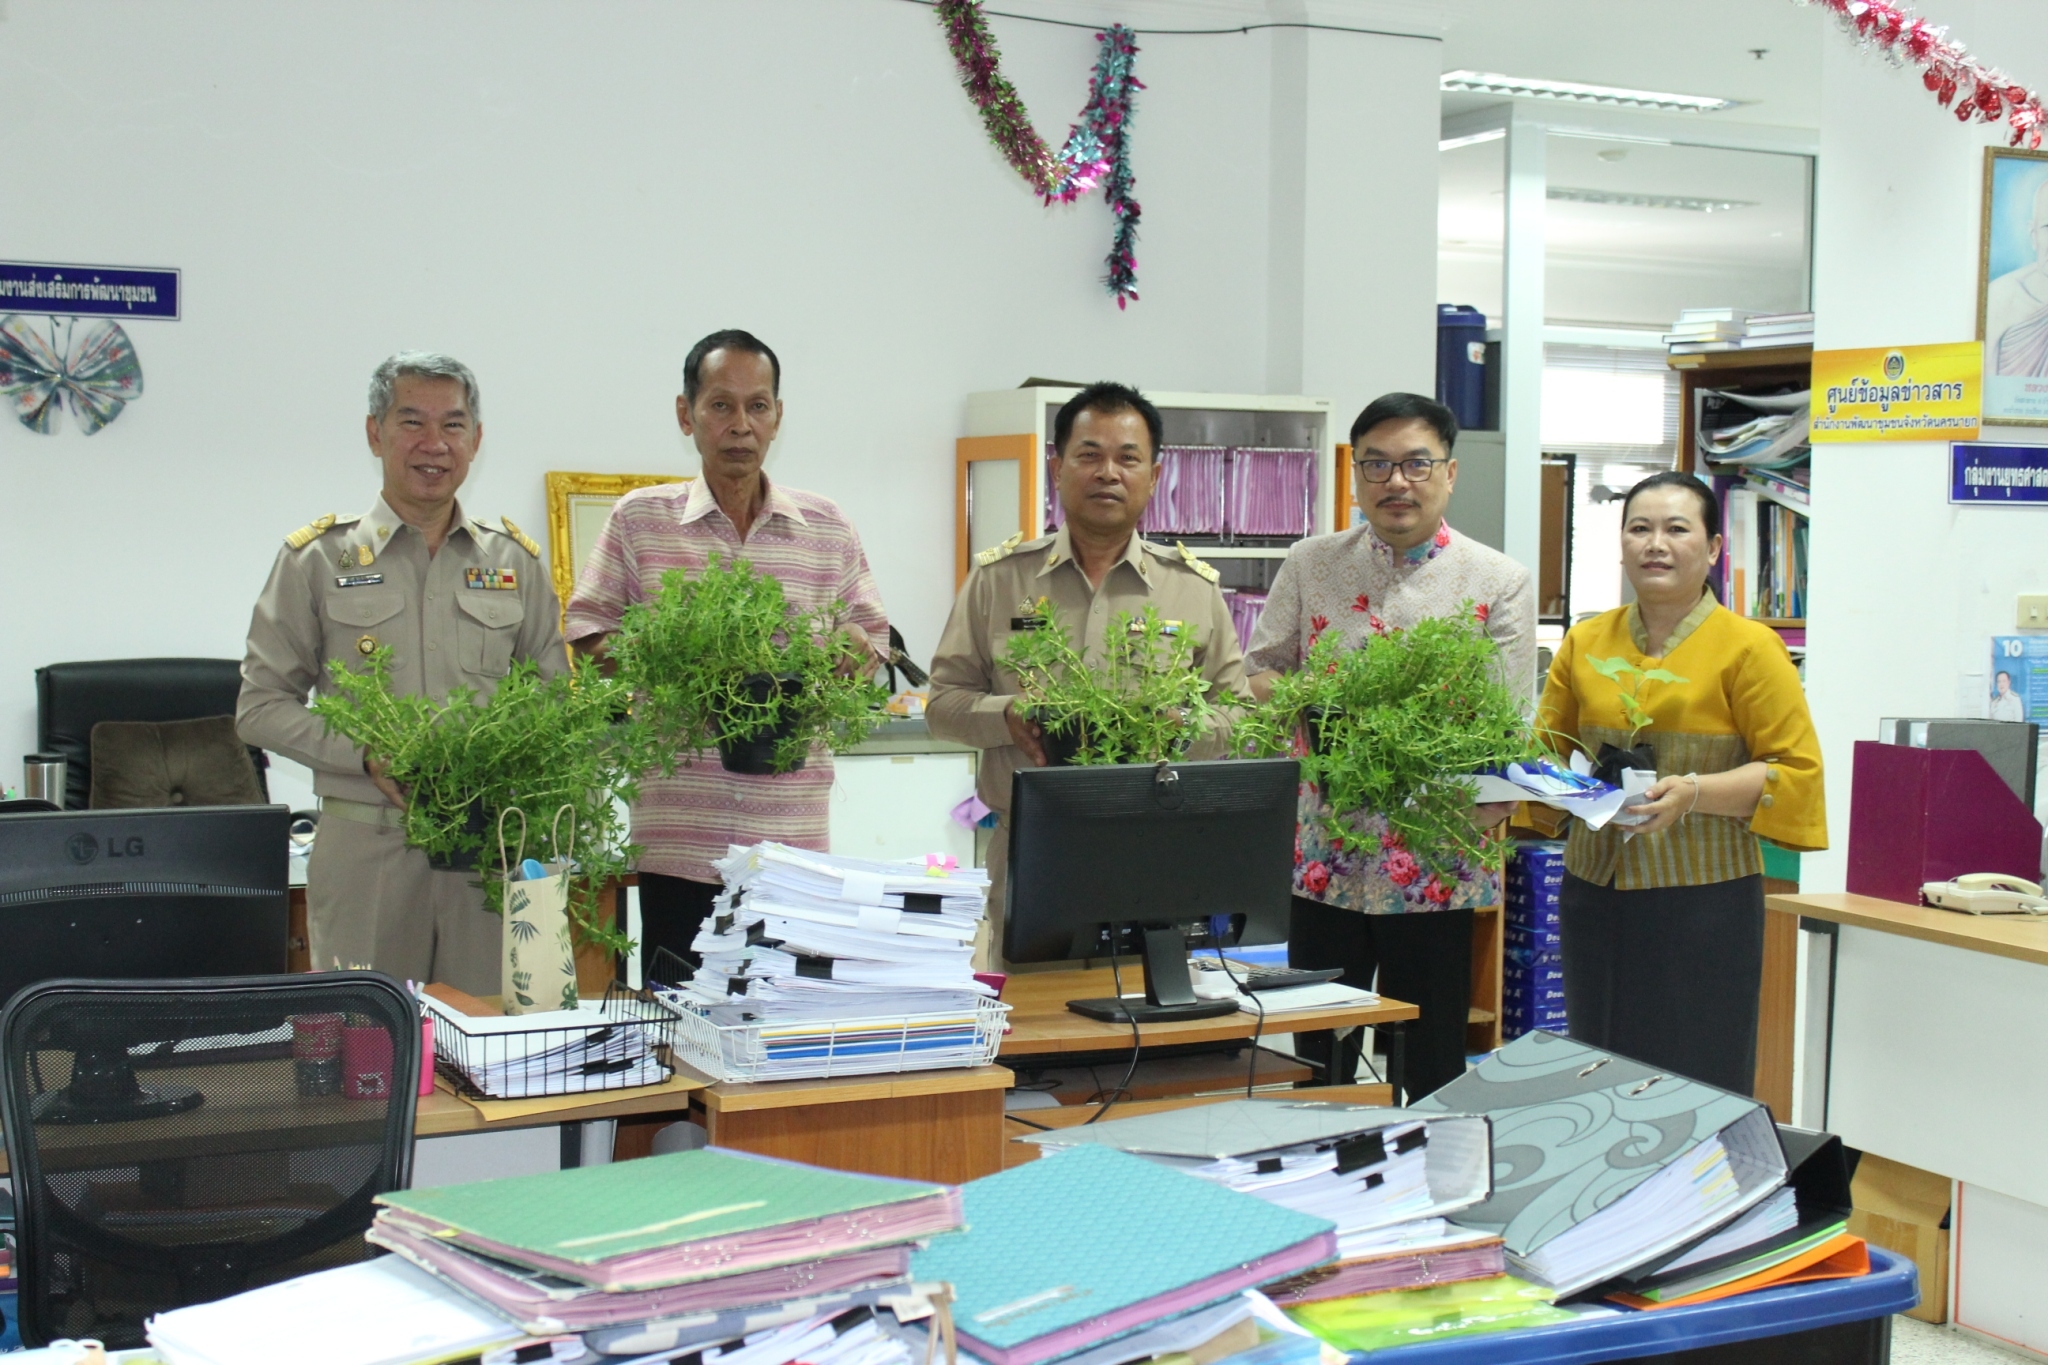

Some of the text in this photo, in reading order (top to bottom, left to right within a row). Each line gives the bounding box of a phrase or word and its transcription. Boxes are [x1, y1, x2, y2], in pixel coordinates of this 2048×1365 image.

[1827, 377, 1963, 413] ศูนย์ข้อมูลข่าวสาร
[1813, 415, 1977, 434] สำนักงานพัฒนาชุมชนจังหวัดนครนายก
[2002, 639, 2023, 658] 10
[107, 836, 145, 857] LG
